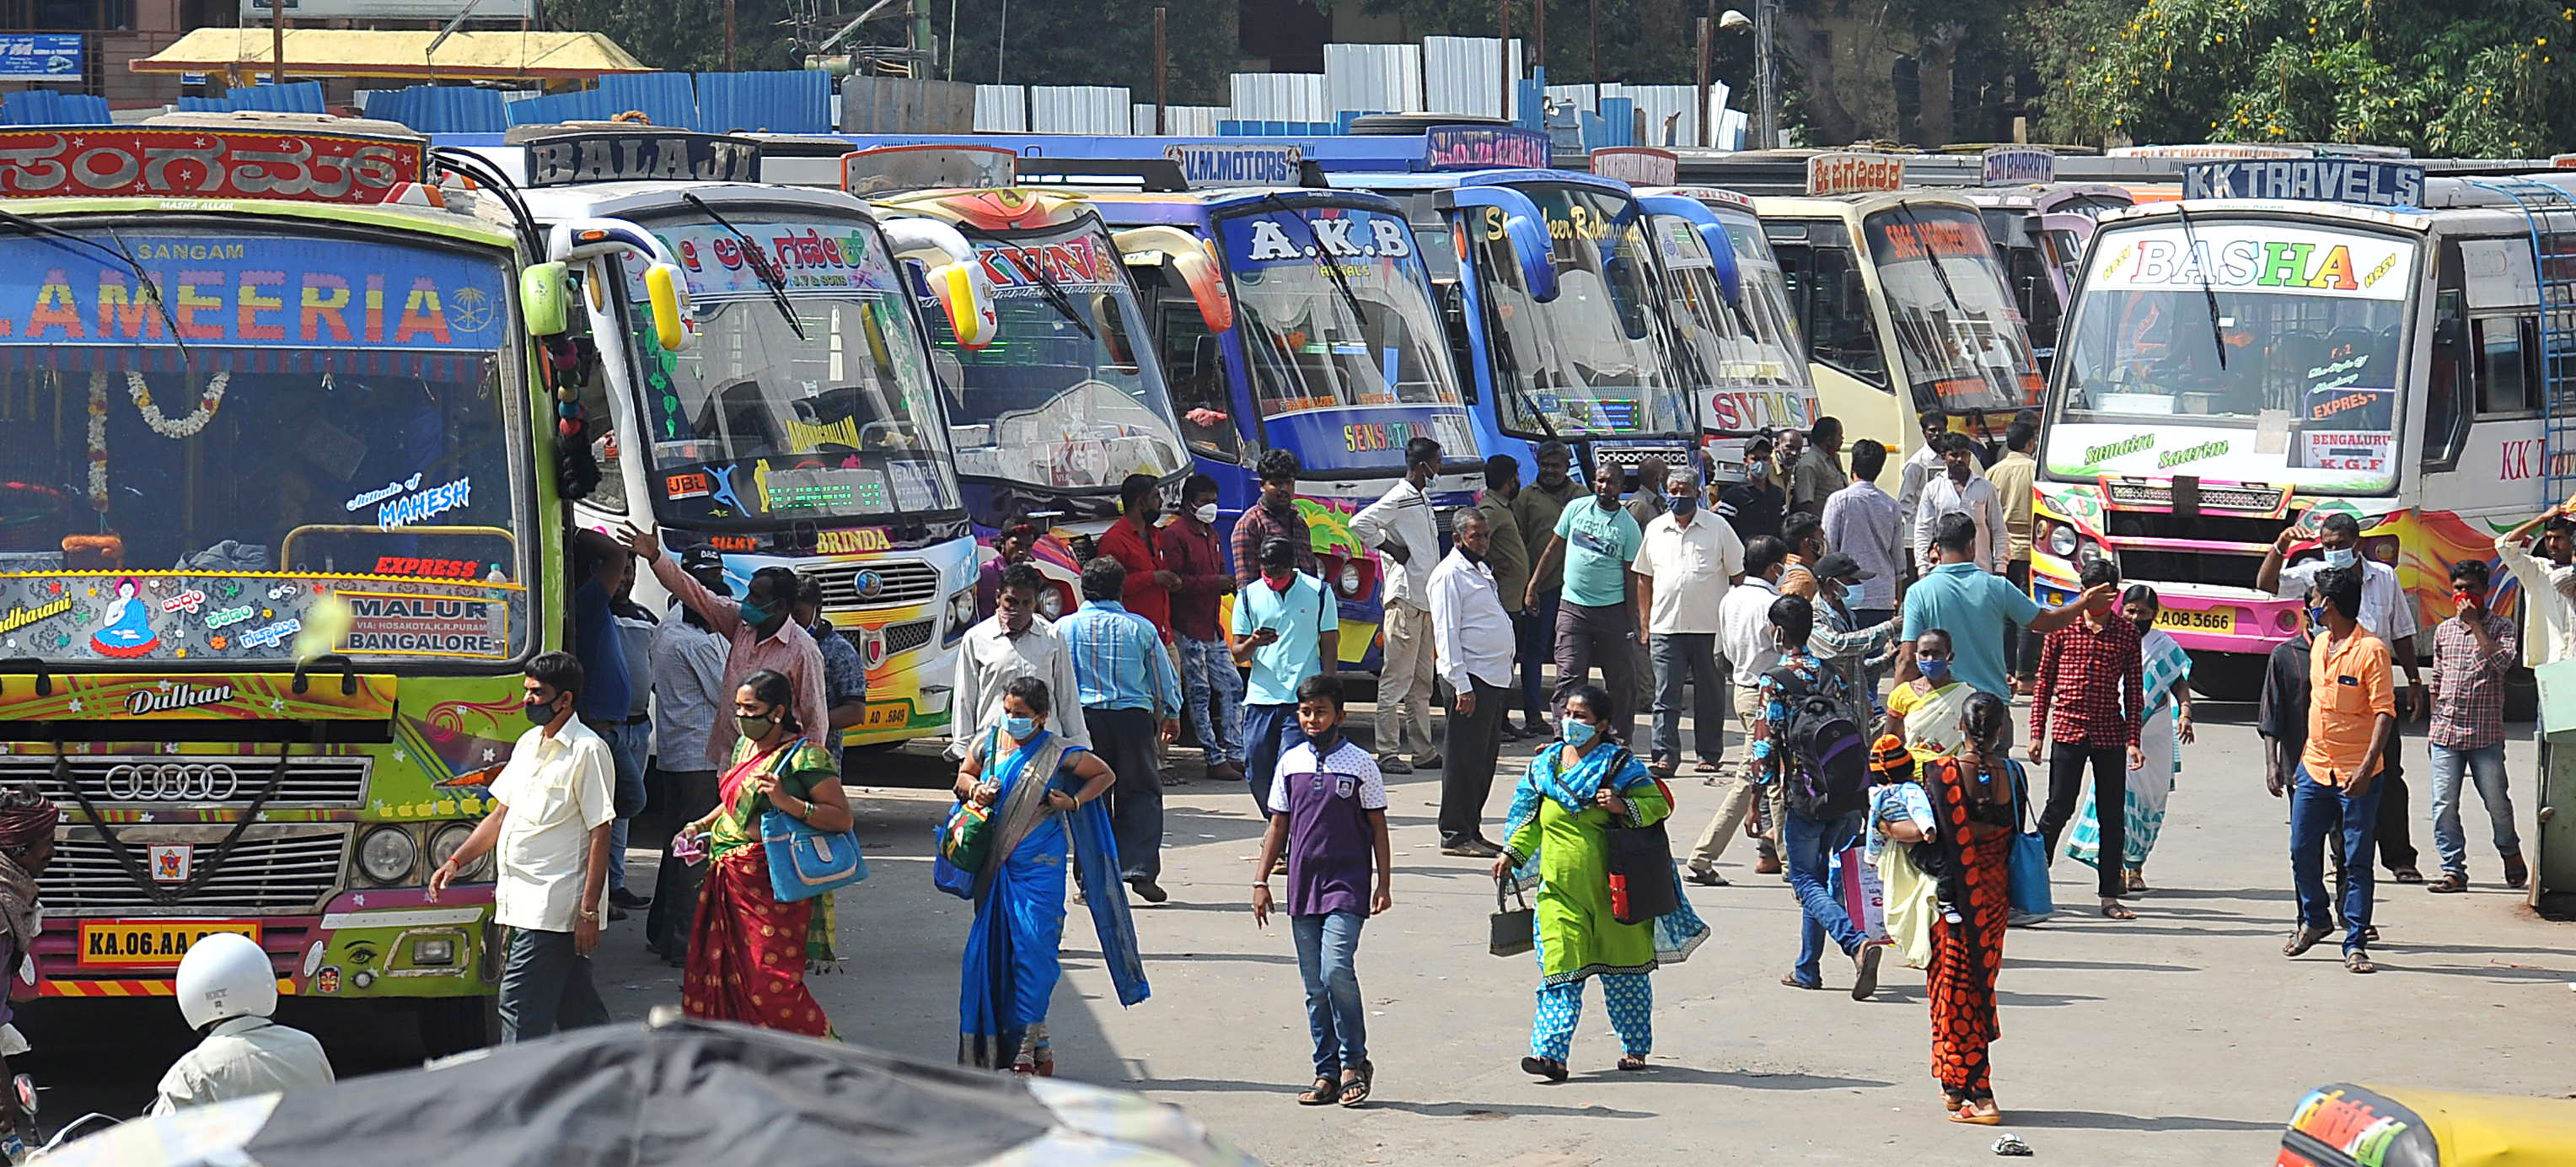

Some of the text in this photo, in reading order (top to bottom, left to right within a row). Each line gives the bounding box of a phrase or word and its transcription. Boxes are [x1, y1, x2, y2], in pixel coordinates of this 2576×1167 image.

[534, 137, 756, 182] BALAJI
[1184, 150, 1287, 181] V.M.MOTORS
[1986, 152, 2053, 182] JAI BHARATH
[2187, 162, 2422, 207] KK TRAVELS
[159, 201, 234, 211] MASHA ALLAH
[137, 243, 244, 261] SANGAM
[1247, 218, 1409, 261] A.K.B
[2130, 239, 2359, 291] BASHA
[0, 268, 452, 344] AMEERIA
[2085, 433, 2155, 466] Sumaira
[2312, 434, 2391, 446] BENGALURU
[2319, 458, 2385, 471] K.G.F
[2499, 438, 2532, 481] KK
[404, 472, 422, 491] of
[669, 476, 707, 492] JBL
[378, 476, 471, 533] MAHESH
[815, 528, 892, 555] BRINDA
[373, 556, 479, 578] EXPRESS
[350, 598, 488, 619] MALUR
[2192, 612, 2230, 630] 3666
[347, 632, 493, 653] BANGALORE
[126, 683, 234, 715] Dulhan
[89, 932, 188, 956] KA.06.AA
